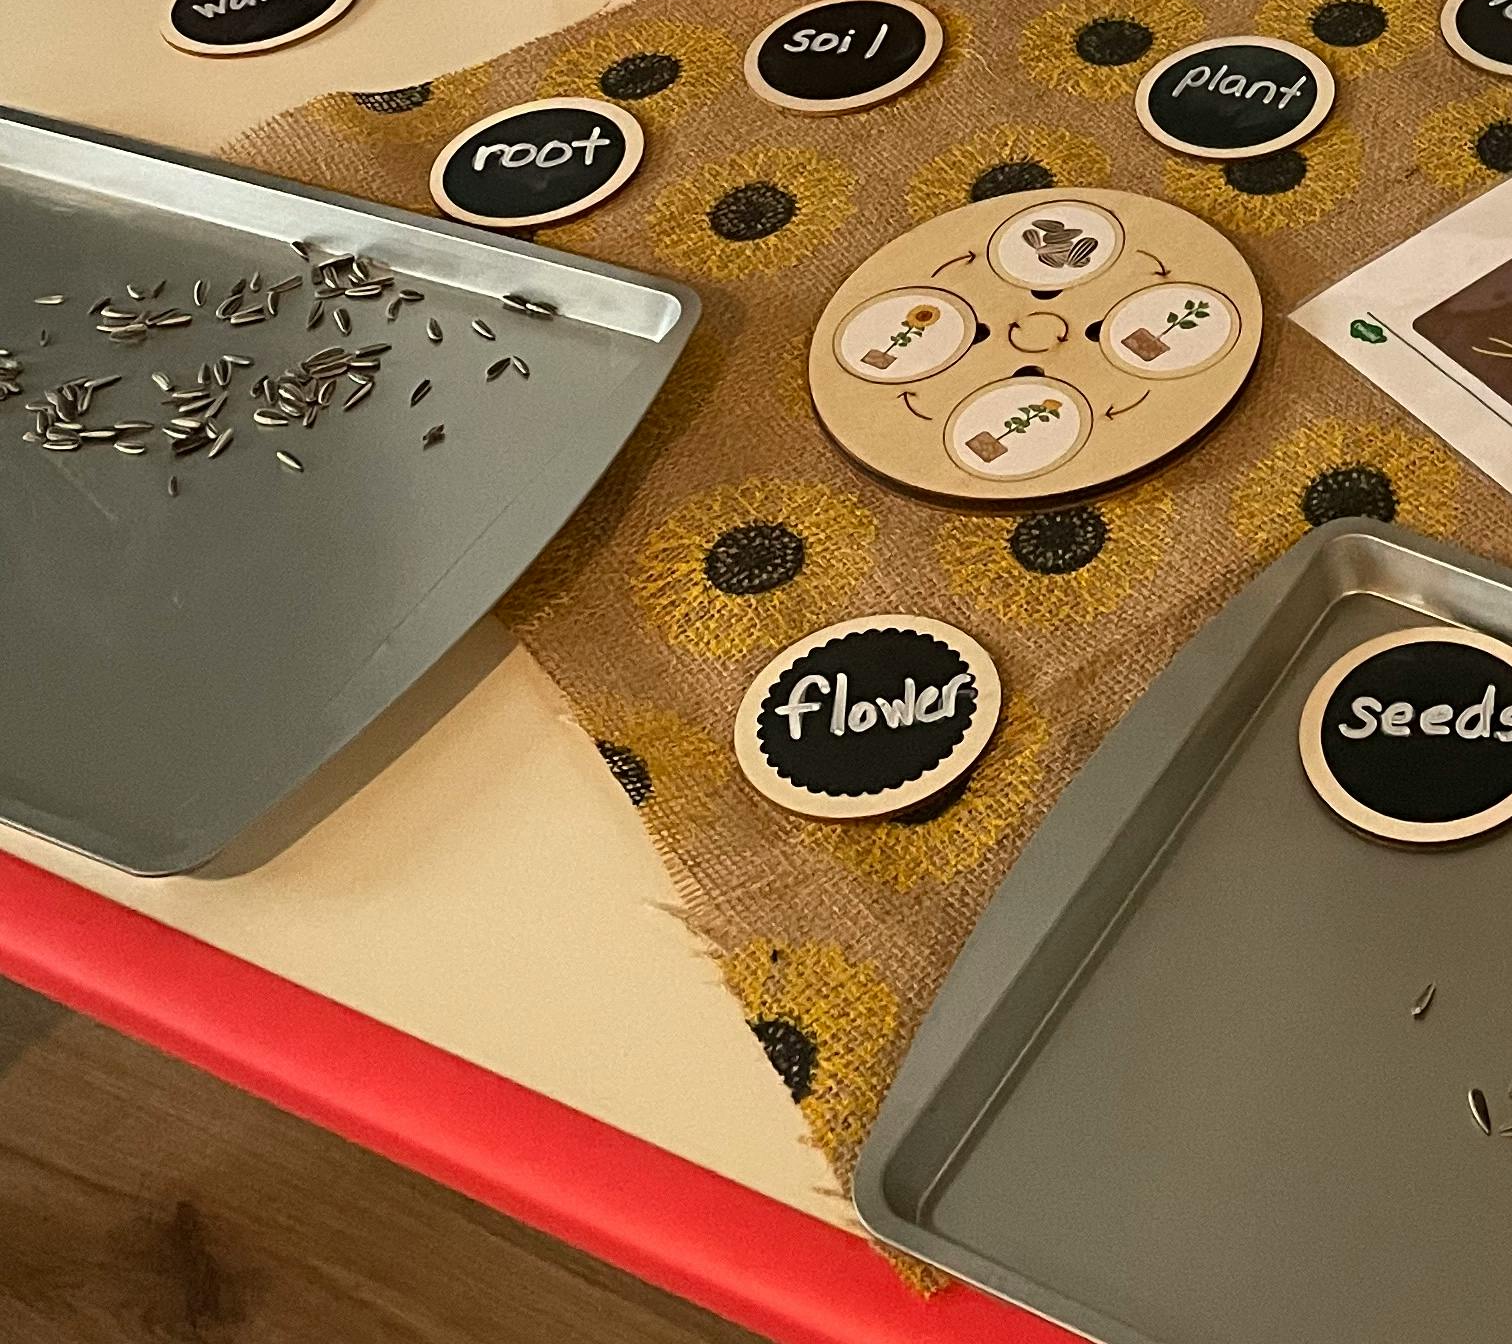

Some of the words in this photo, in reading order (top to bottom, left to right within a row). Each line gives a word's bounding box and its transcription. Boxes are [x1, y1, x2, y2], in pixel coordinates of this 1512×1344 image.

[783, 23, 888, 60] soil
[1171, 62, 1308, 111] plant
[470, 126, 612, 173] root
[774, 672, 978, 741] flower
